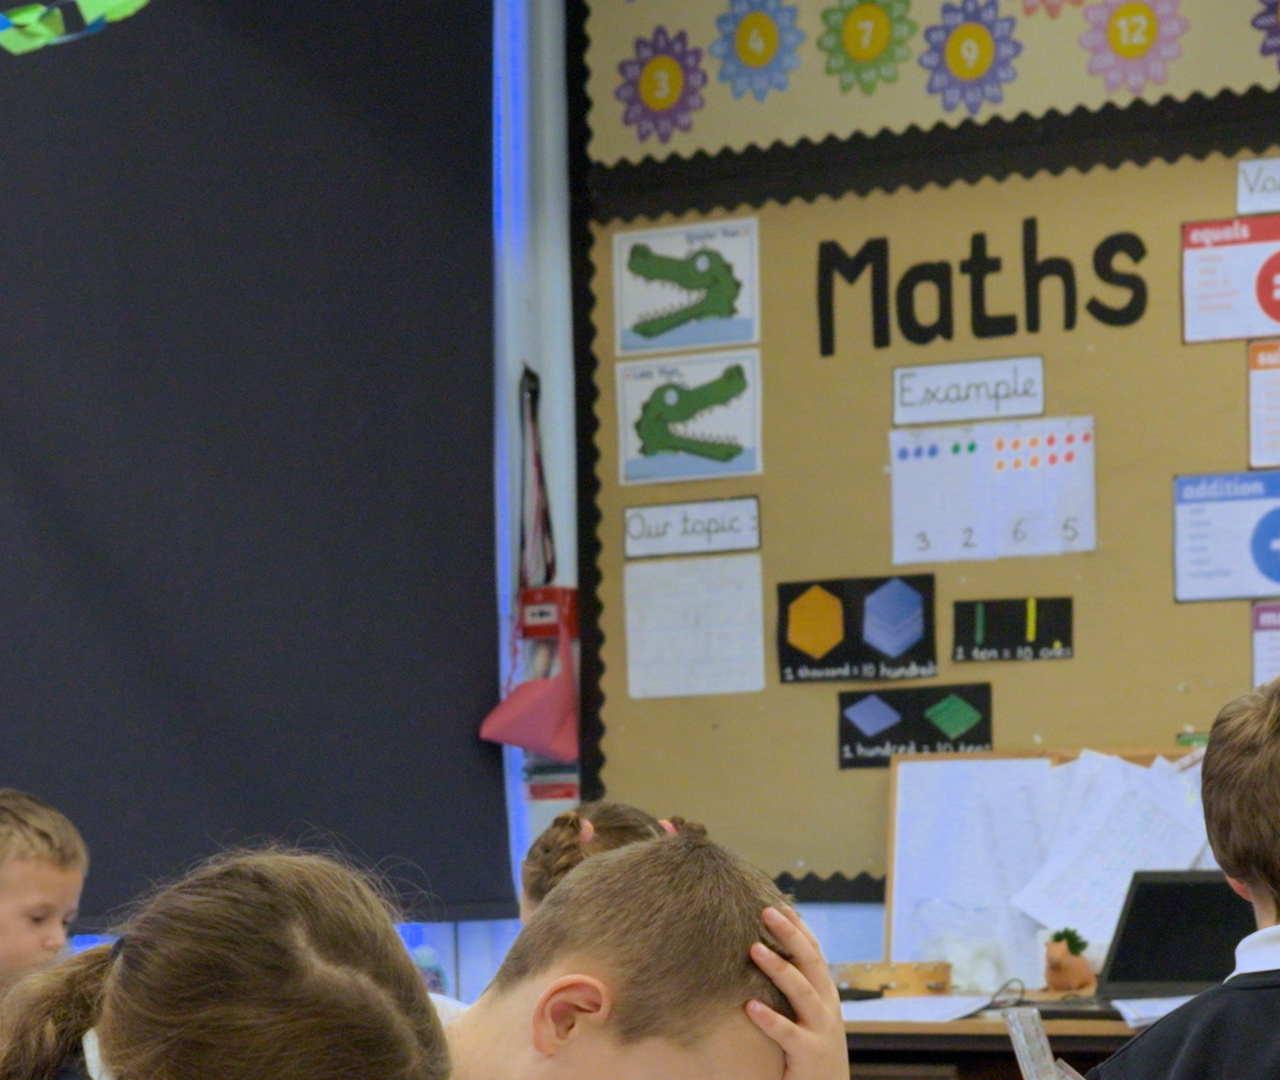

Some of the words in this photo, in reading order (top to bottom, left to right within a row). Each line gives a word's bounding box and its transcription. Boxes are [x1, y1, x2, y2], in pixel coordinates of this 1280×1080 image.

[748, 27, 765, 56] 4
[857, 19, 875, 49] 7
[1117, 16, 1148, 46] 12
[960, 38, 980, 69] 9
[652, 69, 671, 100] 3
[1189, 220, 1251, 248] equals
[817, 215, 1148, 357] Maths
[897, 365, 1039, 413] Example
[1181, 478, 1265, 500] addition
[626, 512, 673, 541] Our
[681, 511, 742, 545] topic
[915, 531, 932, 551] 3
[962, 526, 978, 549] 2
[1012, 518, 1028, 542] 6
[1062, 516, 1079, 542] 5
